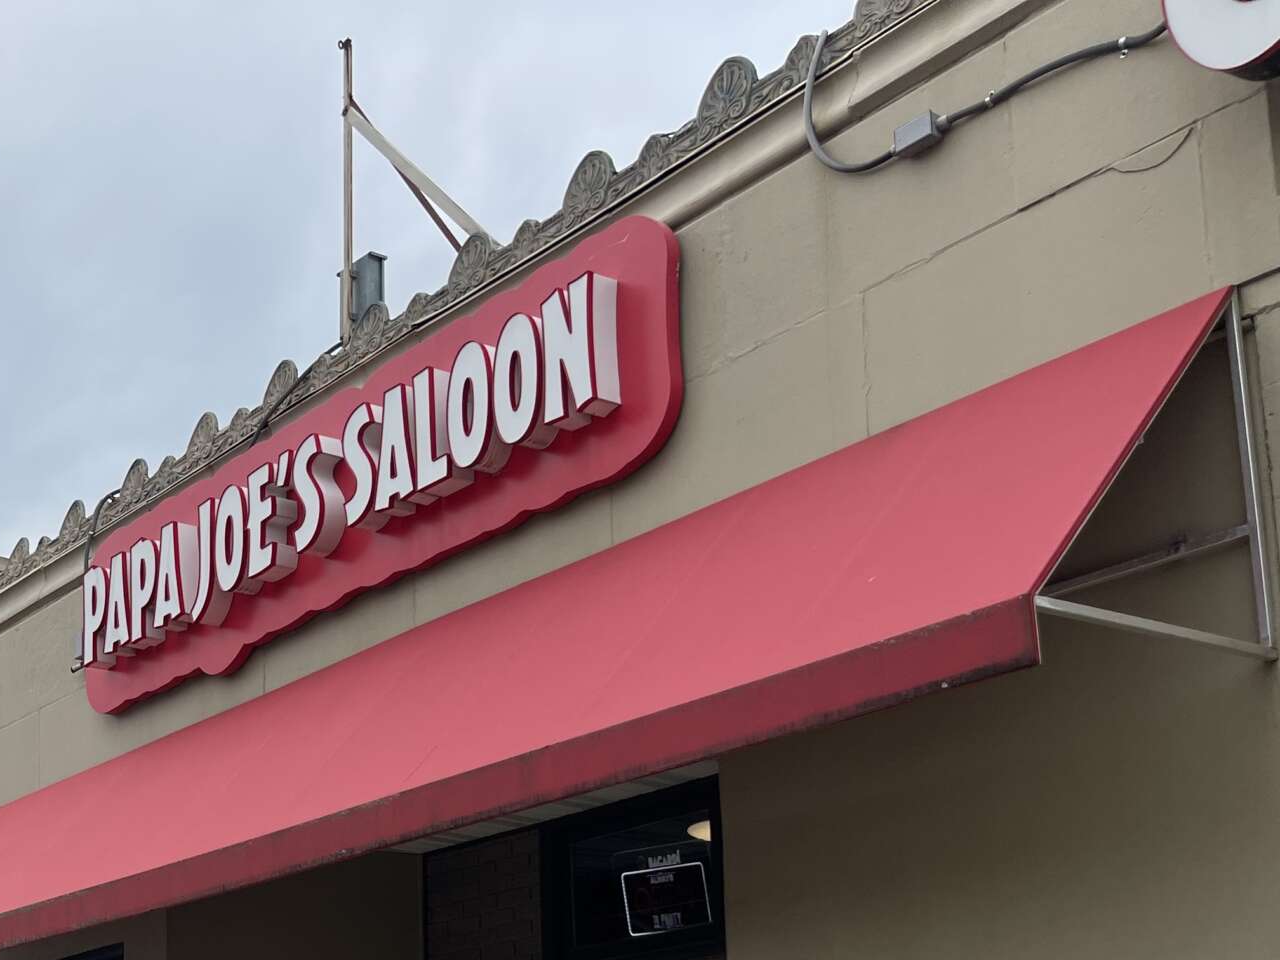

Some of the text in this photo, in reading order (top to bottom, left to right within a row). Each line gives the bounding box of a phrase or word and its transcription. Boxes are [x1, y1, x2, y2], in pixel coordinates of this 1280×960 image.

[82, 270, 620, 668] PAPA JOE'S SALOON
